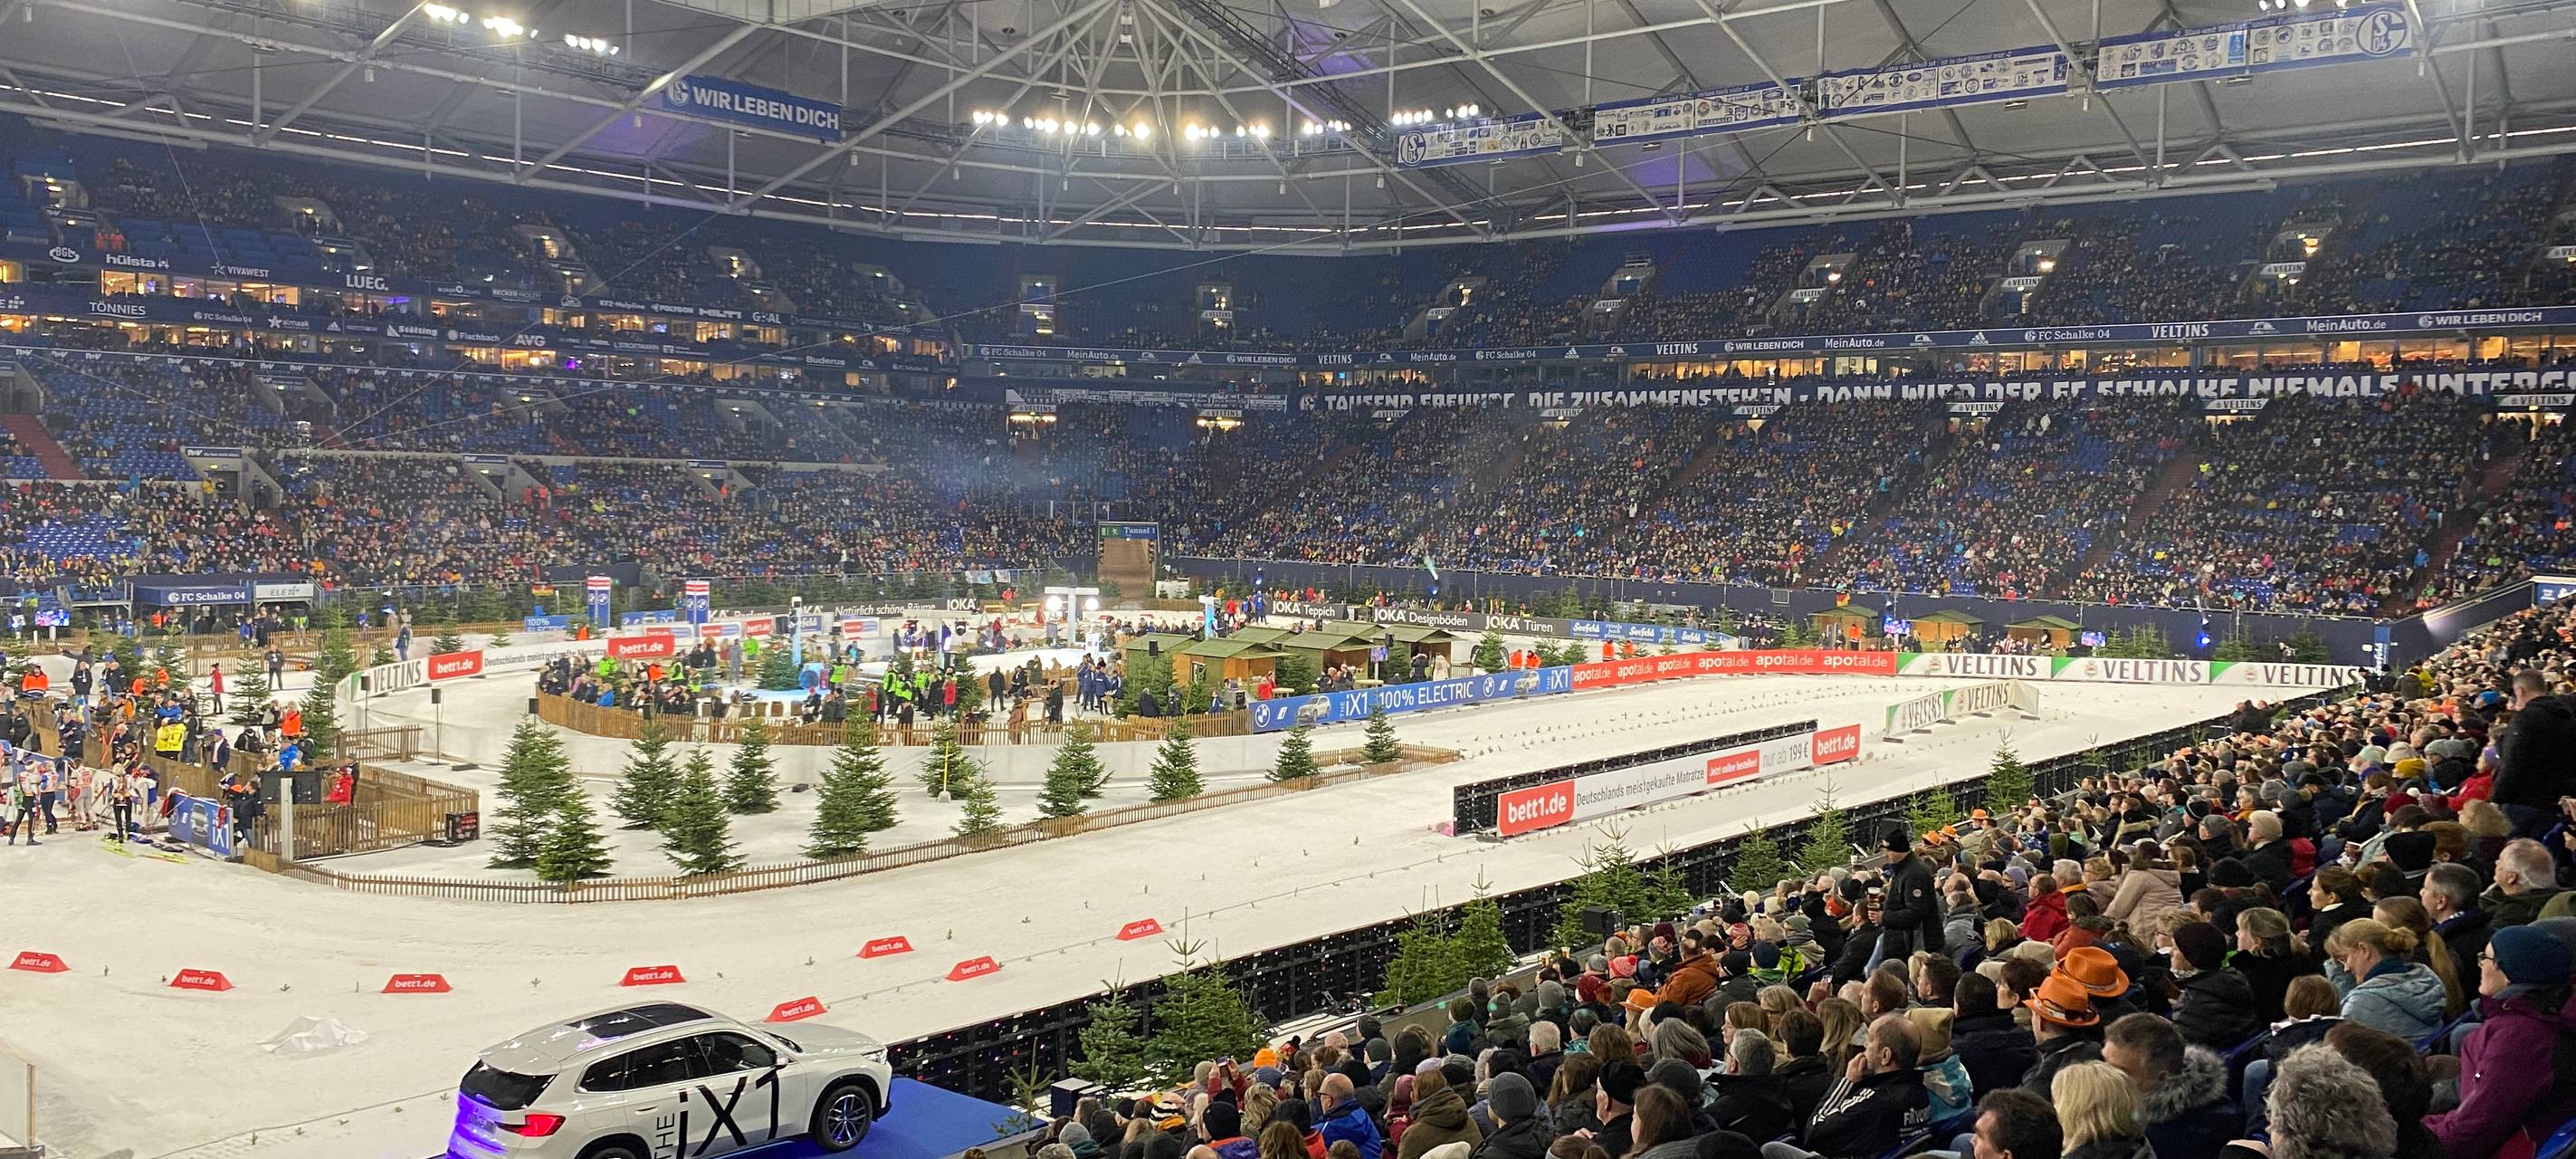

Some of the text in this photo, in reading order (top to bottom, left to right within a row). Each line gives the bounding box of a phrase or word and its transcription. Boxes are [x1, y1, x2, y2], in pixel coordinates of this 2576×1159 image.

[692, 86, 839, 130] WIR LEBEN DICH
[106, 253, 156, 269] hülsta
[227, 265, 269, 279] VIVAWEST
[346, 274, 389, 292] LUEG.
[88, 301, 147, 317] TÖNNIES
[2306, 318, 2387, 332] MeinAuto.de
[2437, 312, 2543, 325] WIR LEBEN DICH
[2038, 329, 2110, 340] FC Schalke 04
[2151, 323, 2209, 340] VELTINS
[514, 333, 546, 347] AVG
[1735, 340, 1804, 350] WIR LEBEN DICH
[1825, 337, 1884, 349] MeinAuto.de
[991, 349, 1046, 358] FC Schalke 04
[1067, 350, 1119, 360] MeinAuto.de
[1484, 350, 1536, 359] FC Schalke 04
[1655, 343, 1698, 355] VELTINS
[806, 355, 845, 366] Buderus
[1253, 356, 1274, 364] LEBEN
[1318, 354, 1352, 365] VELTINS
[1411, 351, 1456, 362] MeinAuto.de
[1529, 391, 1564, 407] DIE
[1818, 384, 1893, 401] DANN
[1985, 381, 2042, 401] DER
[2520, 397, 2567, 405] VELTINS
[1964, 403, 1999, 411] VELTINS
[2223, 400, 2263, 408] VELTINS
[1123, 526, 1150, 534] Tunnel
[180, 591, 245, 601] FC Schalke 04
[270, 588, 287, 597] ELE
[835, 604, 873, 617] Natürlich
[875, 603, 905, 615] schöne
[947, 598, 978, 611] JOKA
[1272, 601, 1335, 618] JOKA Teppich
[1374, 608, 1468, 626] JOKA Designböden
[1485, 615, 1553, 632] JOKA Türen
[1572, 622, 1600, 634] Seefeld
[1628, 624, 1655, 637] Seefeld
[619, 640, 664, 654] bett1.de
[437, 657, 474, 673] bett1.de
[1698, 652, 1750, 669] apotal.de
[1756, 650, 1814, 667] apotal.de
[1823, 651, 1888, 668] apotal.de
[1947, 655, 2037, 676] VELTINS
[373, 659, 422, 687] VELTINS
[1617, 662, 1654, 679] apotal.de
[1657, 658, 1691, 674] apotal.de
[2104, 660, 2201, 683] VELTINS
[1550, 668, 1569, 690] iX1
[1573, 666, 1611, 685] apotal.de
[2263, 665, 2359, 687] VELTINS
[1379, 681, 1474, 710] 100% ELECTRIC
[1968, 682, 2008, 711] VELTINS
[1346, 692, 1369, 717] iX1
[1908, 694, 1942, 728] VELTINS
[1817, 733, 1856, 756] bett1.de
[1762, 742, 1809, 768] nur ab 199 €
[1709, 766, 1722, 778] Jetzt
[1722, 762, 1739, 775] online
[1507, 769, 1704, 823] bett1.de Deutschlands meistgekaufte Matratze
[1128, 922, 1154, 936] bett1.de
[872, 941, 903, 953] bett1.de
[20, 956, 52, 968] bett1.de
[961, 961, 990, 975] bett1.de
[181, 974, 215, 987] bett1.de
[633, 969, 673, 982] bett1.de
[395, 979, 436, 988] bett1.de
[781, 1001, 816, 1018] bett1.de
[677, 1068, 779, 1159] iX1
